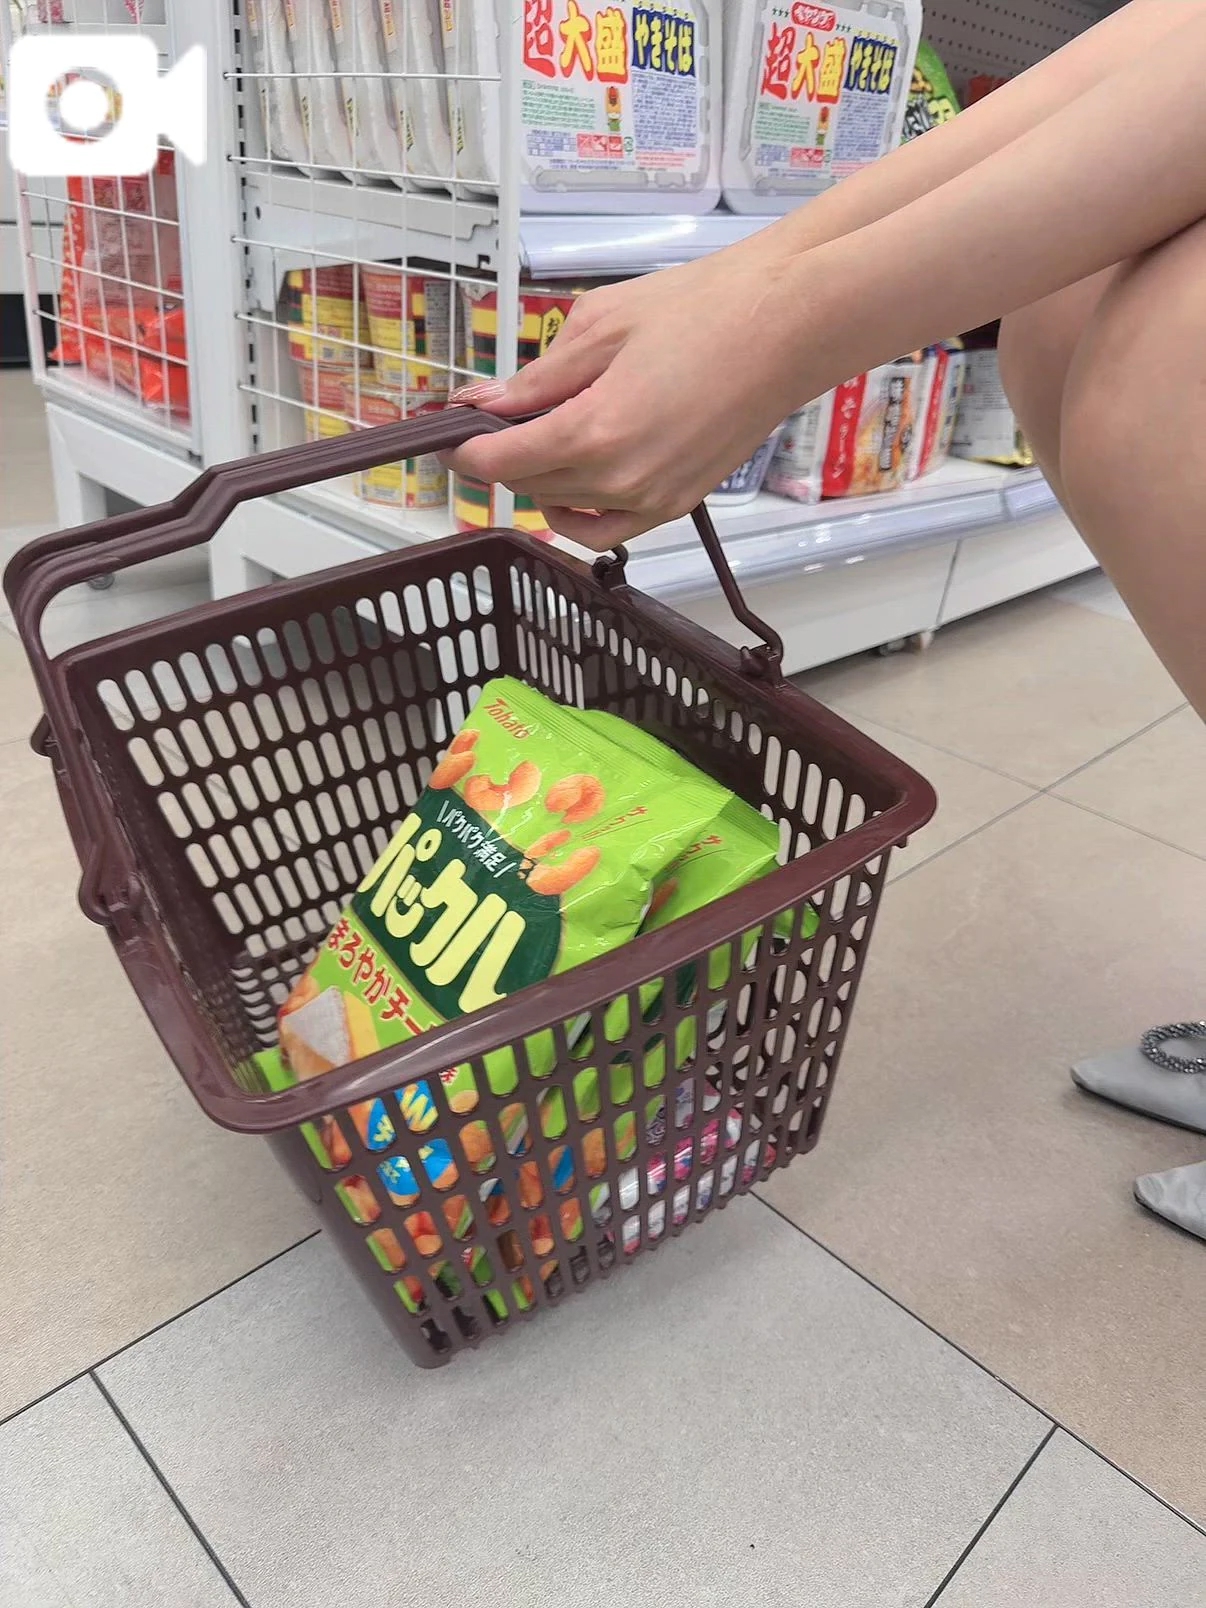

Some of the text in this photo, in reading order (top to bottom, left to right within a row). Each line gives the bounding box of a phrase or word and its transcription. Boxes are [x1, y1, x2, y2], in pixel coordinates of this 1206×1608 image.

[524, 0, 628, 84] 超大盛
[634, 13, 693, 73] やきそば
[761, 22, 894, 105] 超大盛 やきそば
[483, 696, 529, 739] Tohato
[441, 808, 508, 872] パクパク満足
[358, 812, 526, 1013] パックル
[328, 918, 437, 1036] まろやかチー
